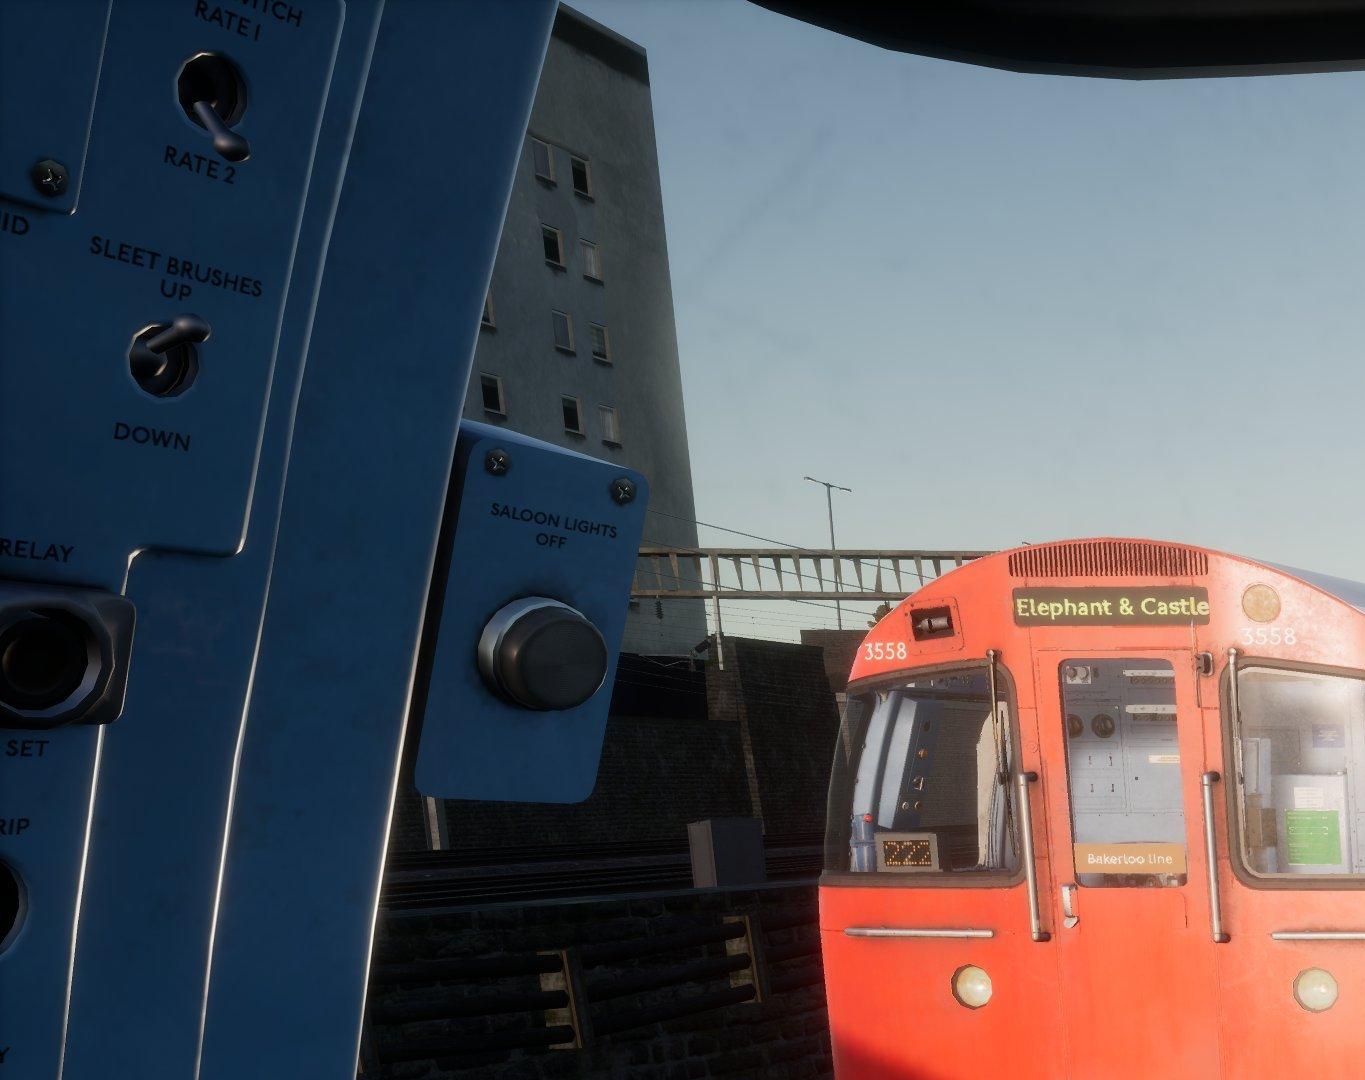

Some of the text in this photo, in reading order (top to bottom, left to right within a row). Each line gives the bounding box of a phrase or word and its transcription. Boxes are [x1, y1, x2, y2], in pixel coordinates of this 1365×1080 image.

[195, 0, 251, 37] RATE
[164, 145, 236, 184] RATE 2
[90, 236, 263, 298] SLEET BRUSHES
[160, 279, 192, 301] UP
[114, 421, 191, 452] DOWN
[490, 502, 617, 538] SALOON LIGHTS
[0, 538, 75, 562] RELAY
[536, 533, 567, 549] OFF
[1016, 597, 1210, 621] Elephant & Castle
[1242, 627, 1297, 646] 3558
[864, 643, 907, 660] 3558
[6, 740, 50, 757] SET
[1087, 852, 1173, 866] Bakerloo line
